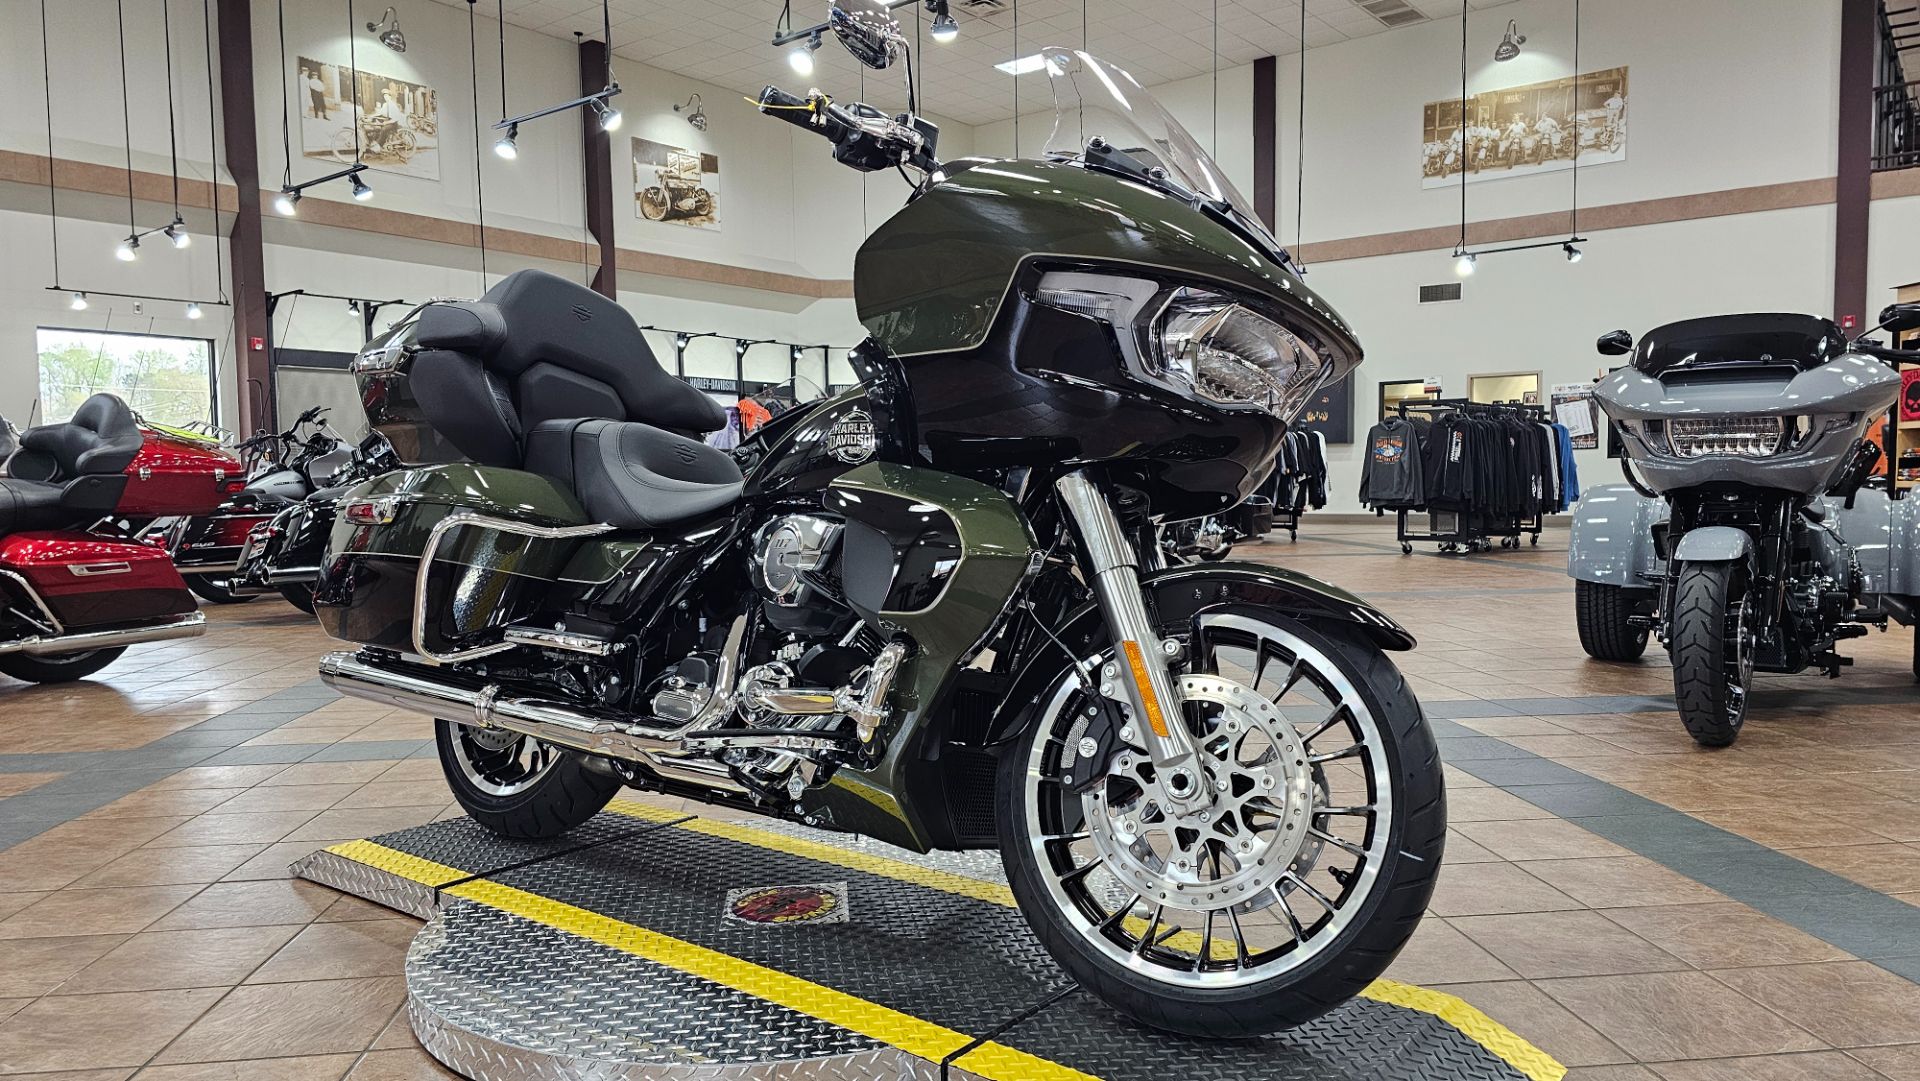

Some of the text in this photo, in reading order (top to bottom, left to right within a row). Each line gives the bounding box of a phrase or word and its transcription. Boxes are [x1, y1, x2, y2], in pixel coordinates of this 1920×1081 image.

[690, 377, 736, 391] HARLEY-DAVIDSON
[834, 422, 874, 433] HARLEY
[774, 538, 792, 548] 117
